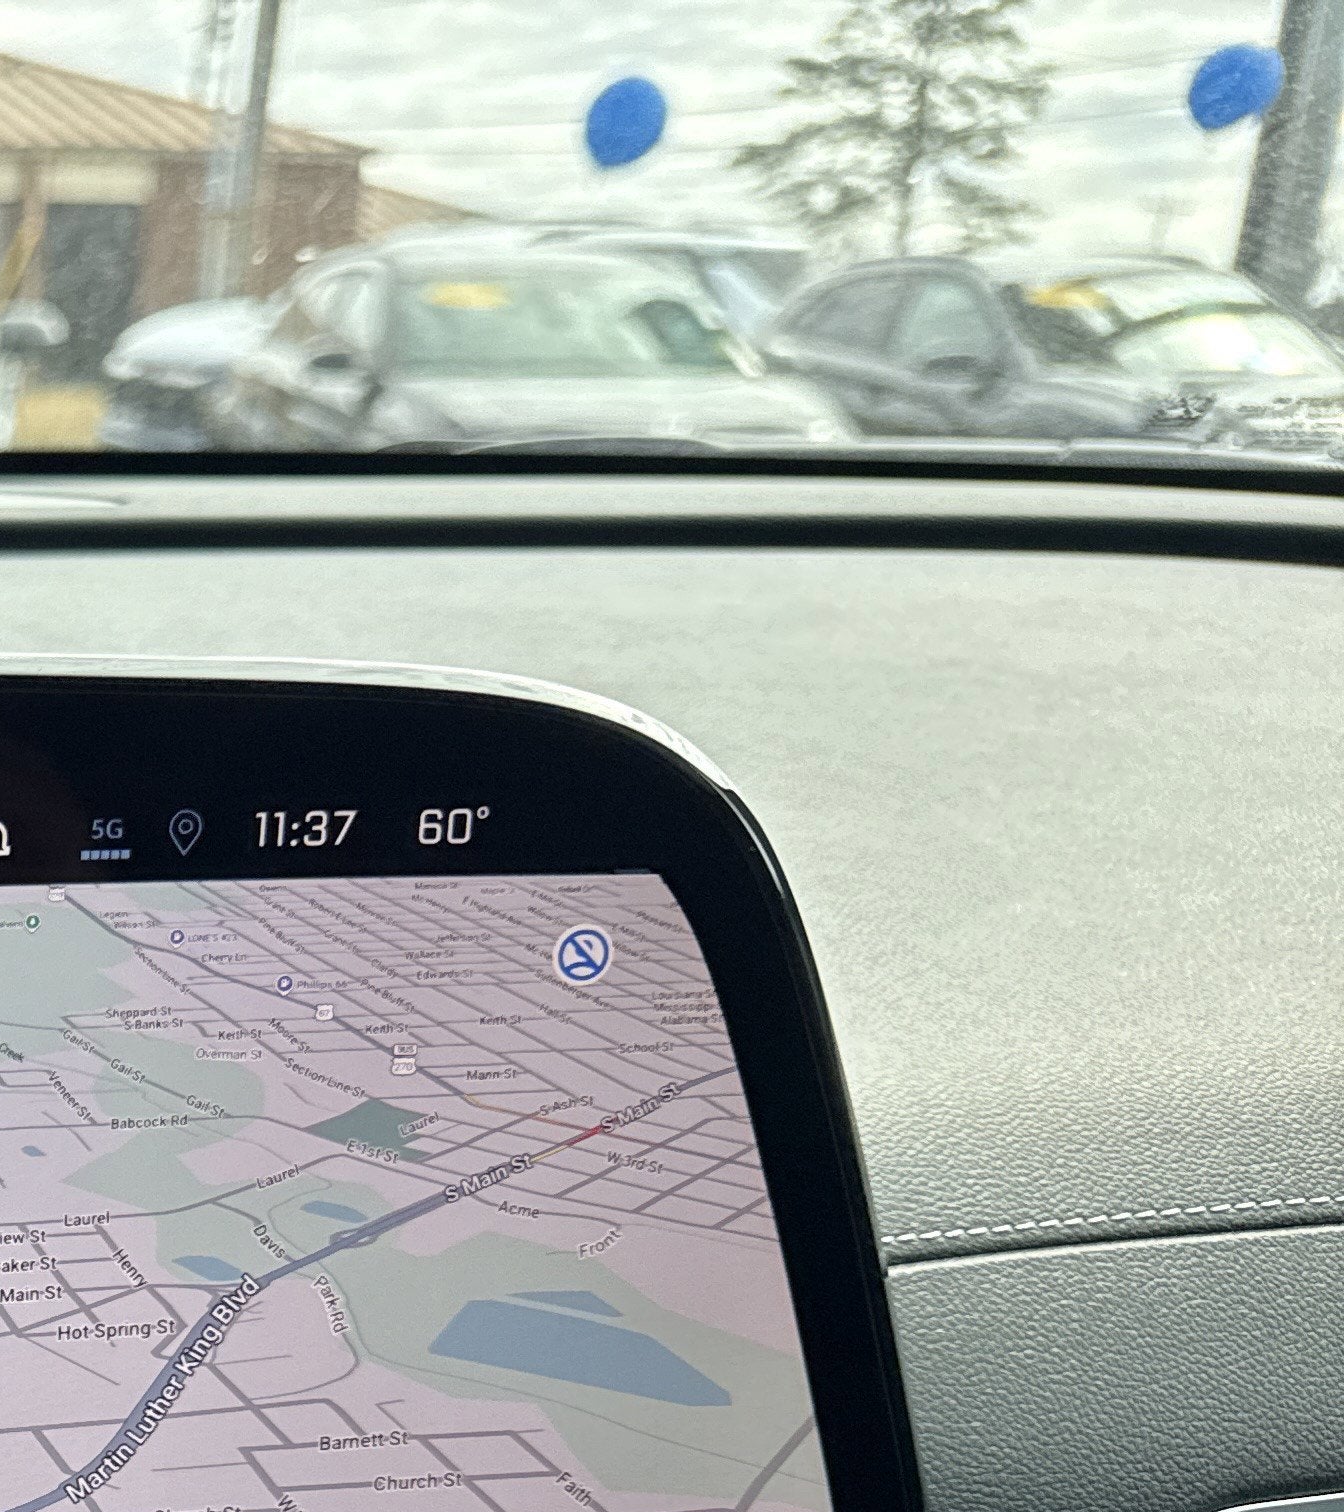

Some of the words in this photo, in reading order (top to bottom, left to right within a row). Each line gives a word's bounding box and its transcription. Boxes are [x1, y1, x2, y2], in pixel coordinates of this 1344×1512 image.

[91, 820, 123, 840] 5G
[255, 811, 358, 848] 11:37
[196, 1048, 246, 1060] Overman
[250, 1050, 262, 1060] St
[111, 1118, 167, 1129] Babcock
[171, 1116, 188, 1126] Rd
[400, 1113, 440, 1136] Laurel
[255, 1164, 300, 1189] Laurel
[445, 1185, 459, 1203] S
[460, 1163, 508, 1196] Main
[511, 1152, 532, 1174] St
[64, 1212, 110, 1226] Laurel
[498, 1200, 540, 1218] Acme
[30, 1230, 46, 1242] St
[252, 1225, 285, 1259] Davis
[578, 1227, 622, 1258] Front
[40, 1257, 56, 1269] St
[113, 1249, 148, 1287] Henry
[0, 1288, 39, 1302] Main
[45, 1286, 62, 1299] St
[58, 1327, 88, 1340] Hot
[95, 1323, 151, 1338] Spring
[157, 1320, 174, 1332] St
[65, 1443, 136, 1503] Martin
[126, 1374, 184, 1443] Luther
[174, 1320, 227, 1376] King
[213, 1274, 260, 1324] Blvd
[320, 1434, 383, 1450] Barnett
[389, 1430, 408, 1446] St
[374, 1475, 436, 1491] Church
[442, 1472, 462, 1488] St
[556, 1470, 593, 1505] Faith
